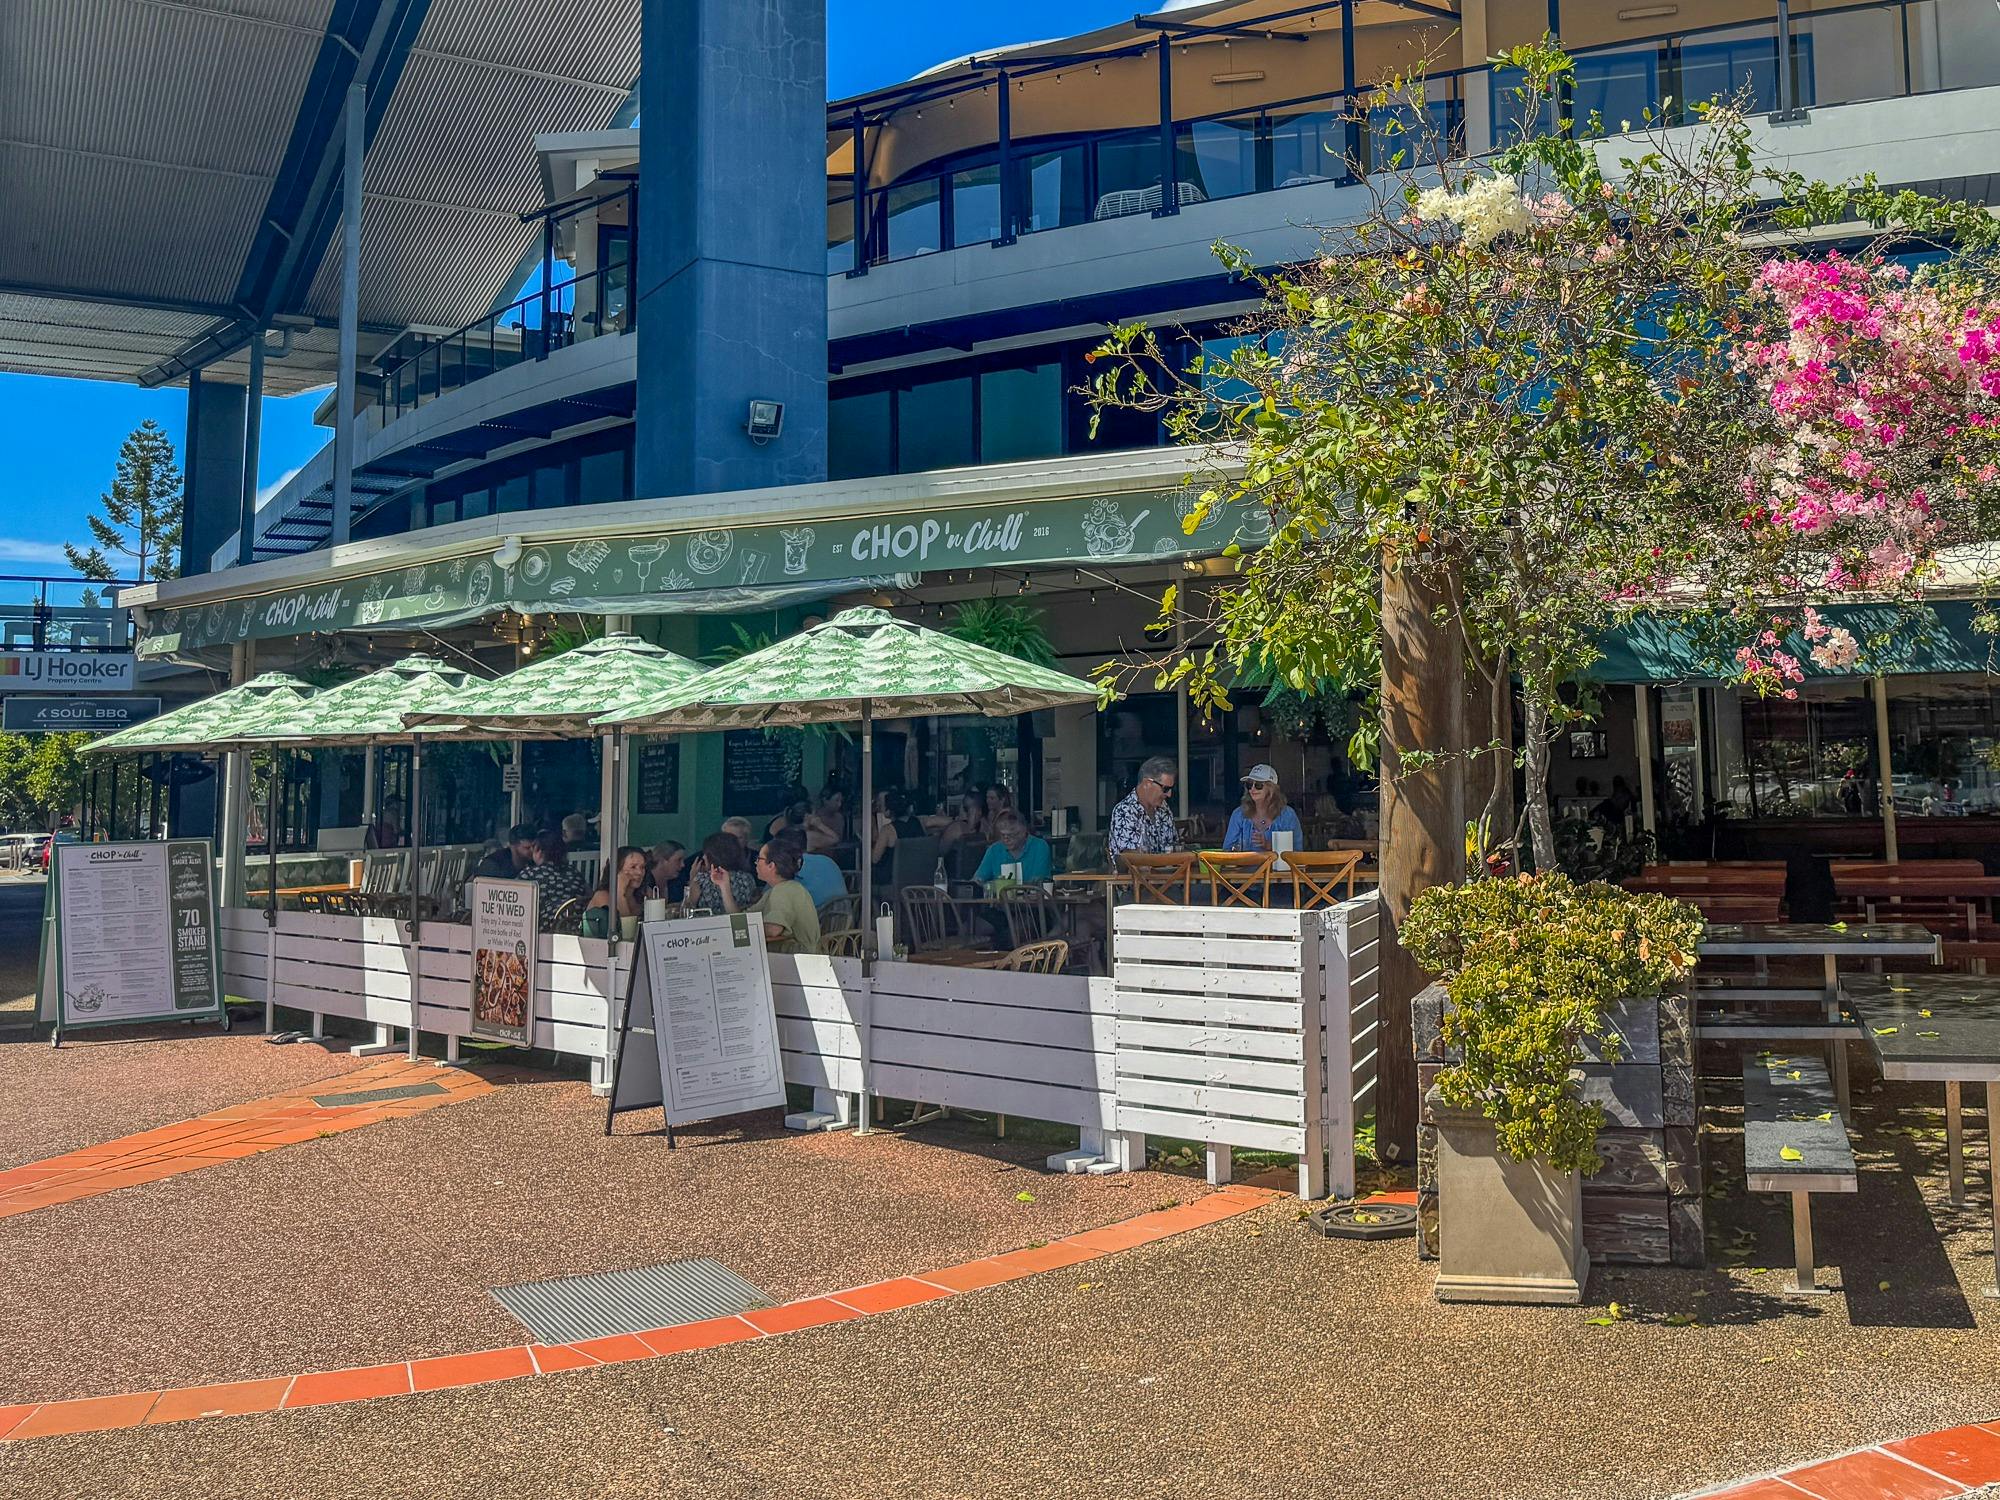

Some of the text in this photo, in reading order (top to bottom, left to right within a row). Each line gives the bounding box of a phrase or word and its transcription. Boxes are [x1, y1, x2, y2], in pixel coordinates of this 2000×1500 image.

[832, 544, 843, 553] EST
[850, 519, 940, 561] CHOP
[963, 512, 1024, 554] Chill
[1033, 527, 1050, 537] 2016
[265, 593, 306, 626] CHOP
[311, 588, 341, 621] Chill
[25, 657, 128, 680] LJ Hooker
[47, 677, 78, 685] Property
[50, 708, 92, 718] SOUL
[95, 708, 128, 719] BBQ
[91, 850, 116, 860] CHOP
[488, 889, 519, 903] WICKED
[481, 902, 495, 914] TUE
[506, 904, 525, 917] WED
[177, 926, 206, 937] SMOKED
[178, 935, 206, 948] STAND
[666, 937, 691, 949] CHOP
[695, 935, 710, 946] Chill
